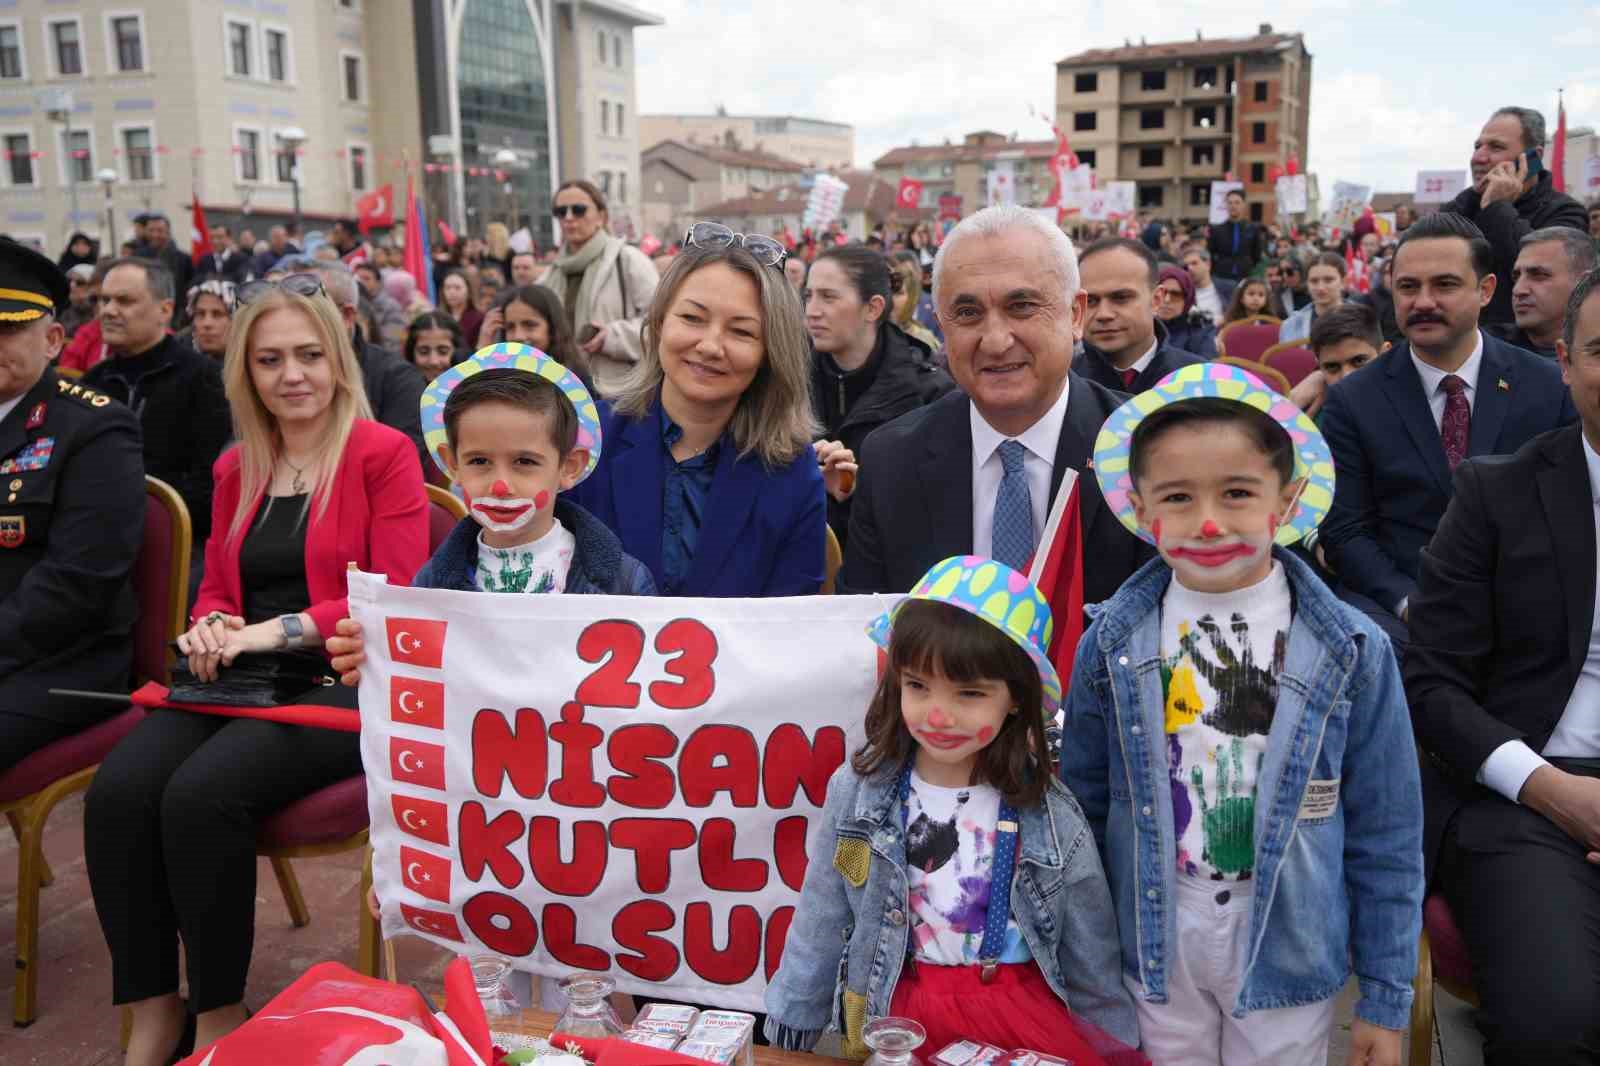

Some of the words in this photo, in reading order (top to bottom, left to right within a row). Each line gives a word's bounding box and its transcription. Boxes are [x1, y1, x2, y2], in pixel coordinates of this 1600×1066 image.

[575, 617, 718, 709] 23
[471, 701, 846, 809] NİSAN
[462, 891, 796, 986] OLSU
